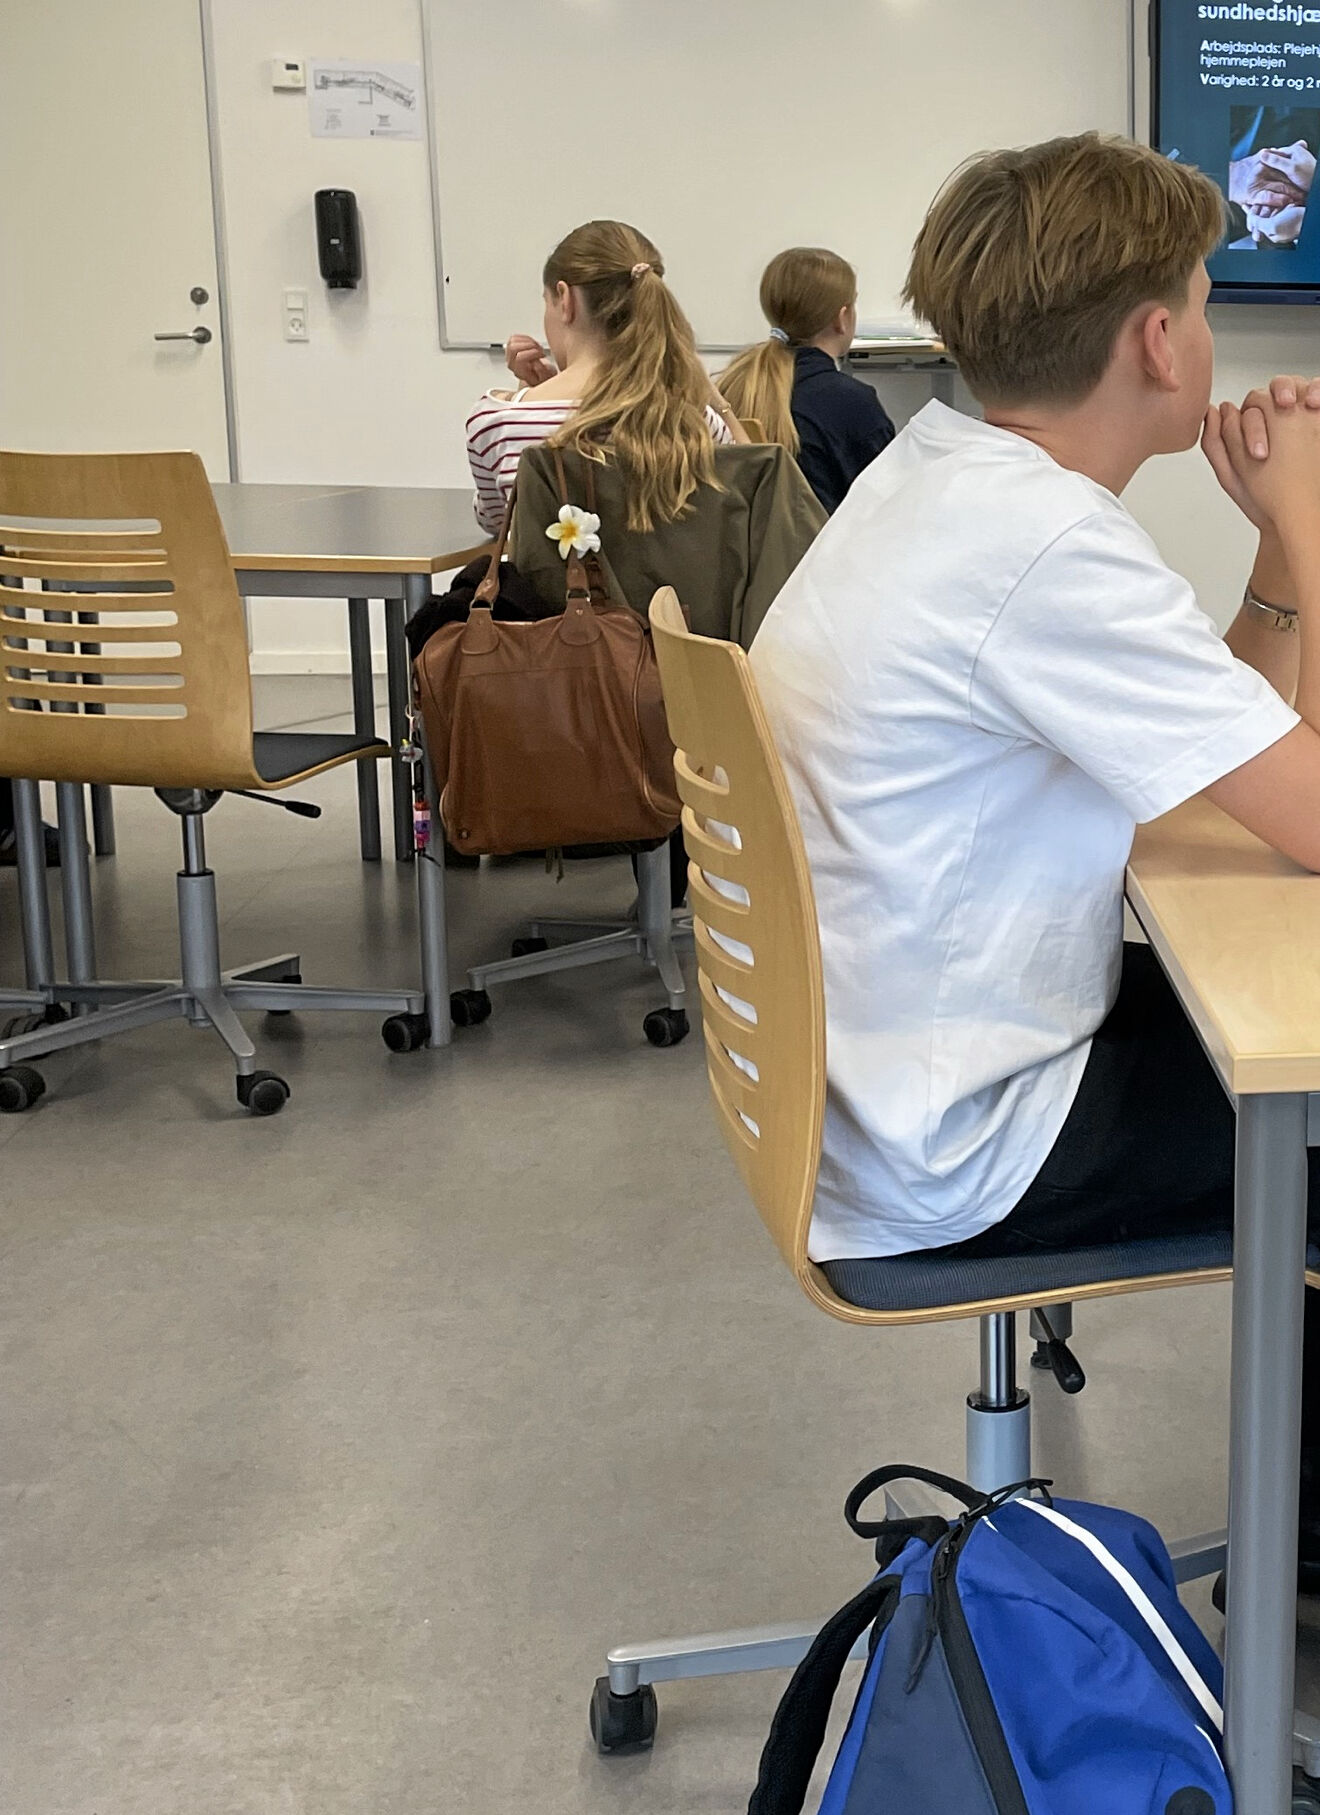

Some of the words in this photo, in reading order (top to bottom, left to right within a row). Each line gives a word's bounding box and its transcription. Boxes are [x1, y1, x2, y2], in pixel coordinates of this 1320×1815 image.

[1200, 40, 1281, 55] Arbejdsplads:
[1200, 54, 1287, 70] hjemmeplejen
[1200, 73, 1260, 88] Varighed:
[1261, 75, 1270, 87] 2
[1271, 75, 1285, 88] år
[1286, 79, 1304, 91] og
[1306, 77, 1314, 89] 2
